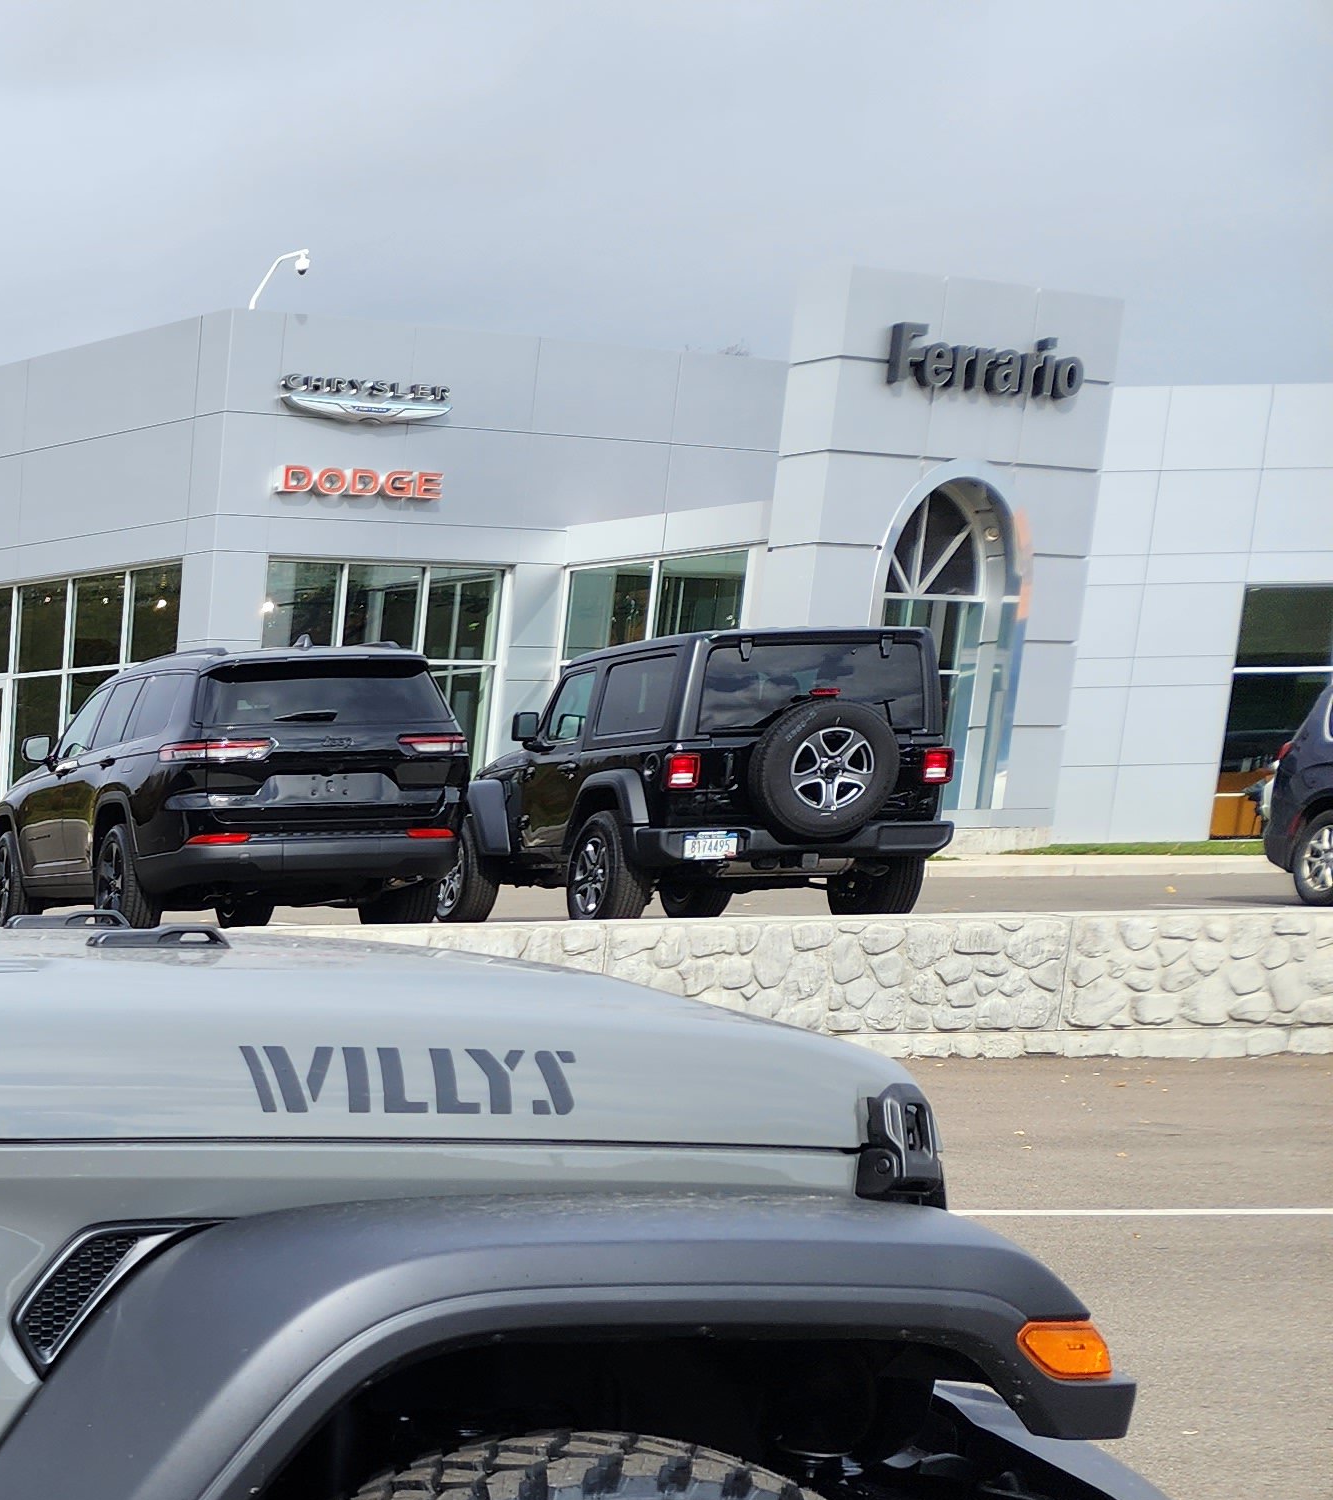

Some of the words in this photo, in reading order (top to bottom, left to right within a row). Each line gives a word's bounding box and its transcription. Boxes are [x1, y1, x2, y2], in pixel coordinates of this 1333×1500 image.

[887, 321, 1085, 399] Ferrario
[281, 373, 451, 400] CHRYSLER
[277, 464, 445, 499] DODGE
[238, 1046, 576, 1115] WILLYS
